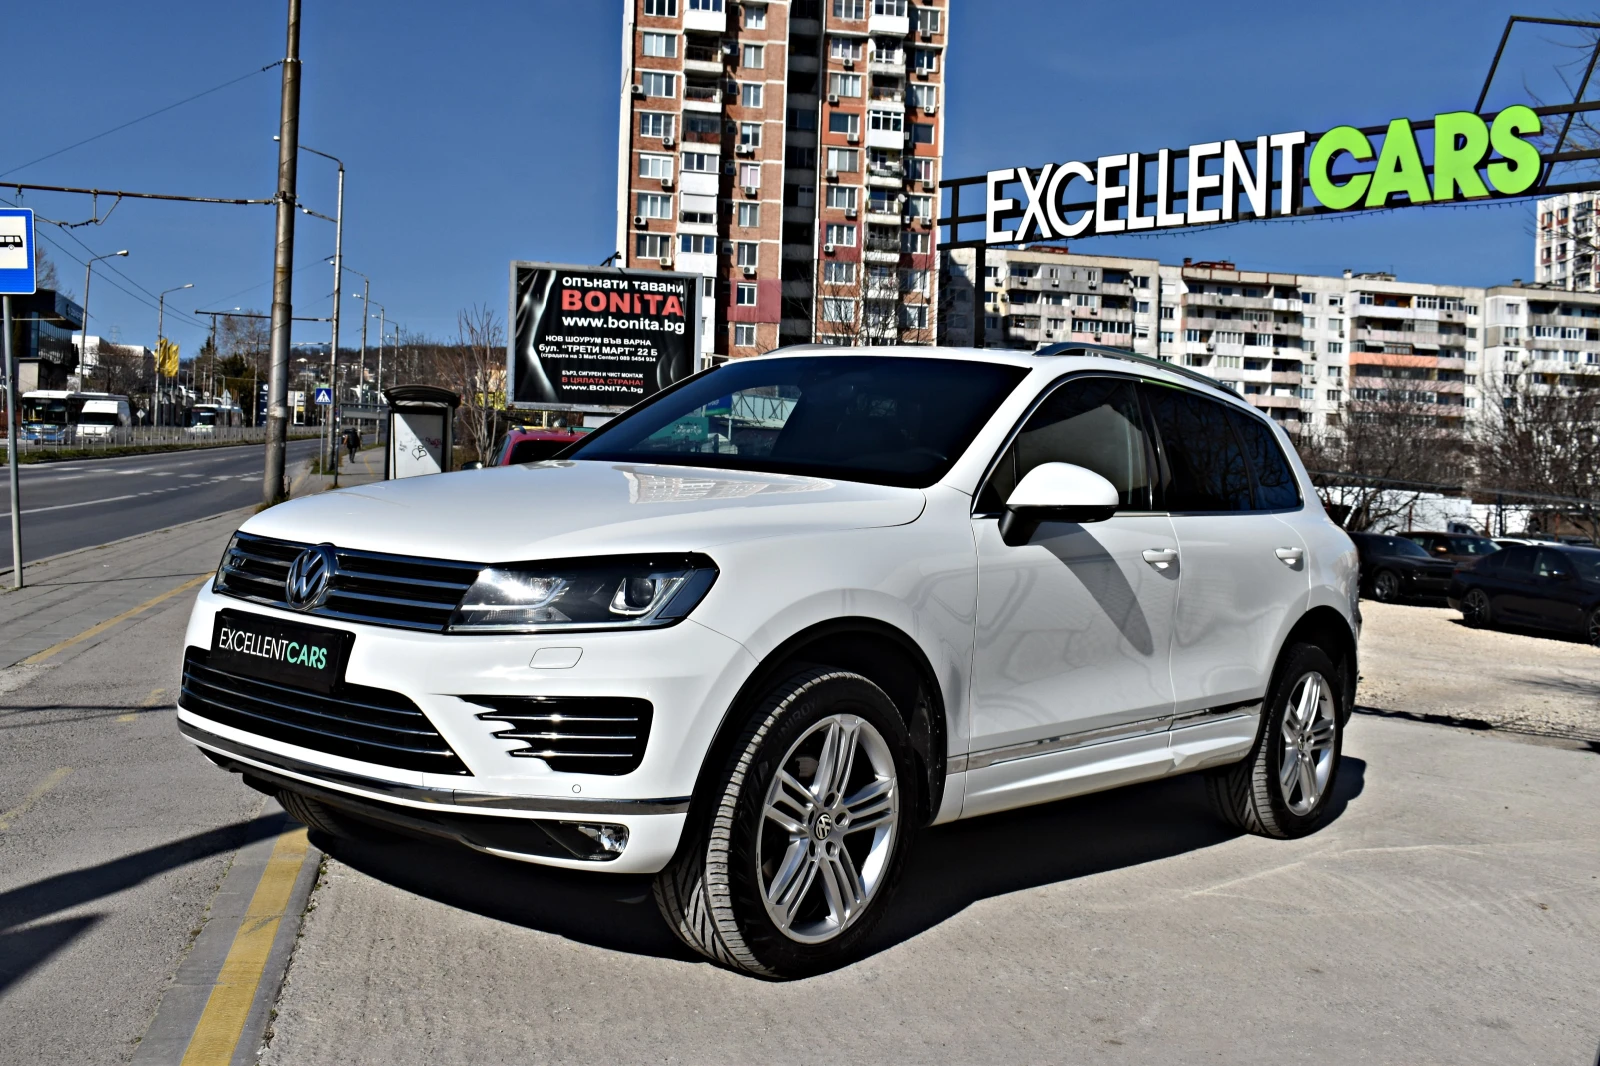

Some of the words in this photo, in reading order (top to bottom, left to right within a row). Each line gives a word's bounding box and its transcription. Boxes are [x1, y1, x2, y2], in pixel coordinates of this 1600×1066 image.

[562, 276, 628, 290] опънати
[632, 280, 684, 294] тавани
[561, 289, 684, 317] BONITA
[562, 316, 685, 335] www.bonita.bg
[565, 335, 602, 344] ШОУРУМ
[603, 337, 622, 345] ВЪВ
[623, 338, 652, 346] ВАРНА
[538, 343, 560, 353] бул.
[637, 348, 649, 356] 22
[607, 378, 644, 386] СТРАНА!
[562, 384, 644, 394] www.BONITA.bg
